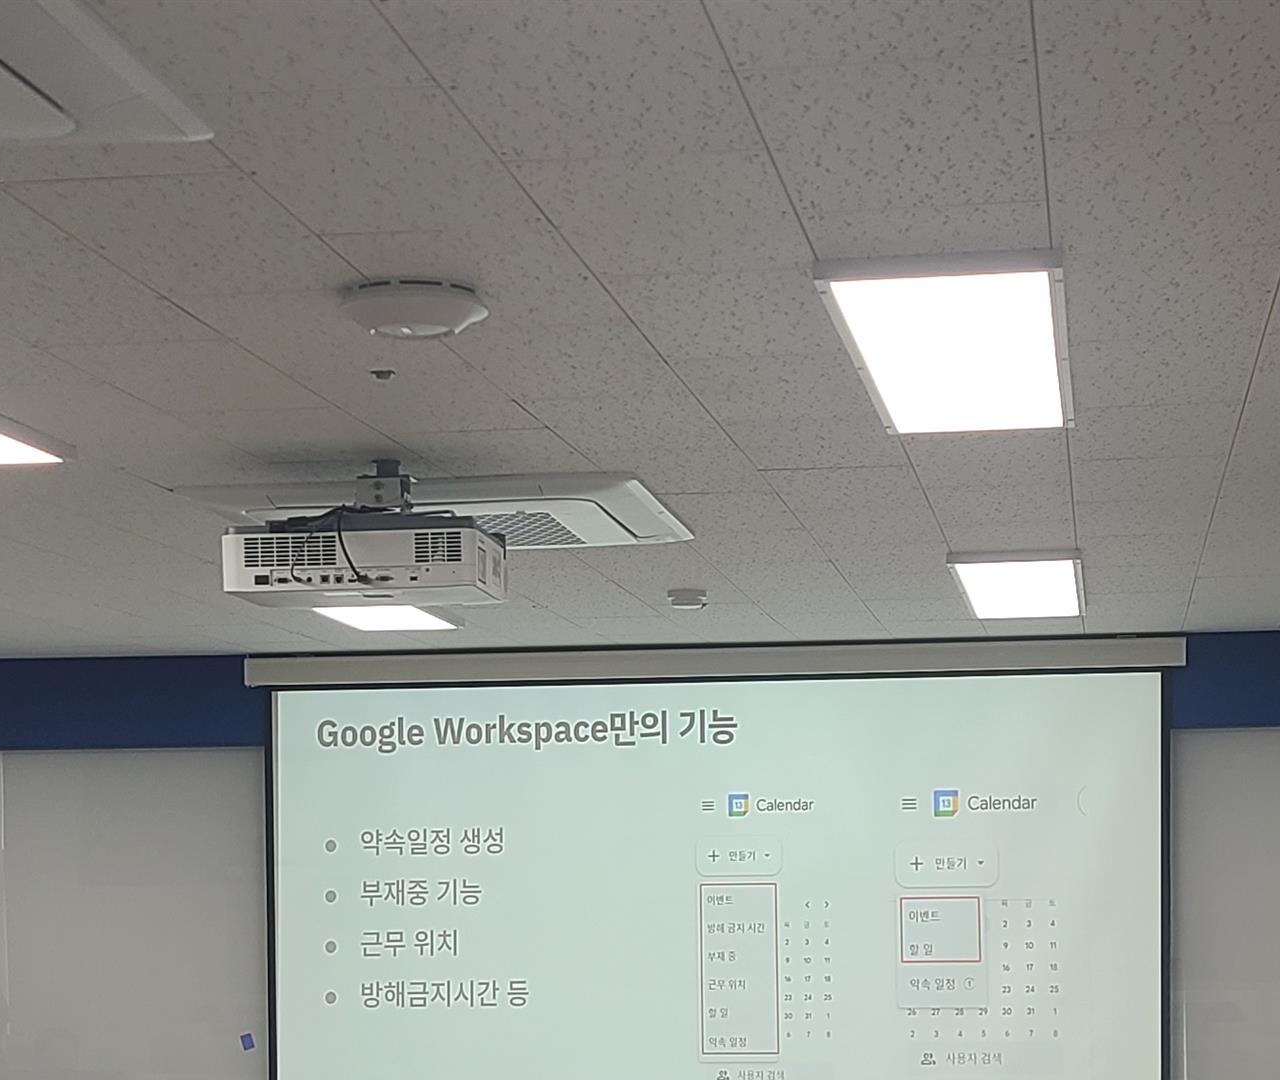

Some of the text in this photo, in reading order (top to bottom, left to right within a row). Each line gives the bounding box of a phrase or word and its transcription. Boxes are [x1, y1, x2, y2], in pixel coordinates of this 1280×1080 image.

[317, 709, 738, 753] Google Workspace만의 기능
[756, 798, 814, 812] Calendar
[967, 796, 1037, 811] Calendar
[360, 826, 505, 857] 약속일정 생성
[728, 850, 757, 862] 만들기
[934, 857, 967, 871] 만들기
[360, 879, 482, 907] 부재중 기능
[360, 930, 459, 958] 근무 위치
[360, 980, 529, 1008] 방해금지시간 등
